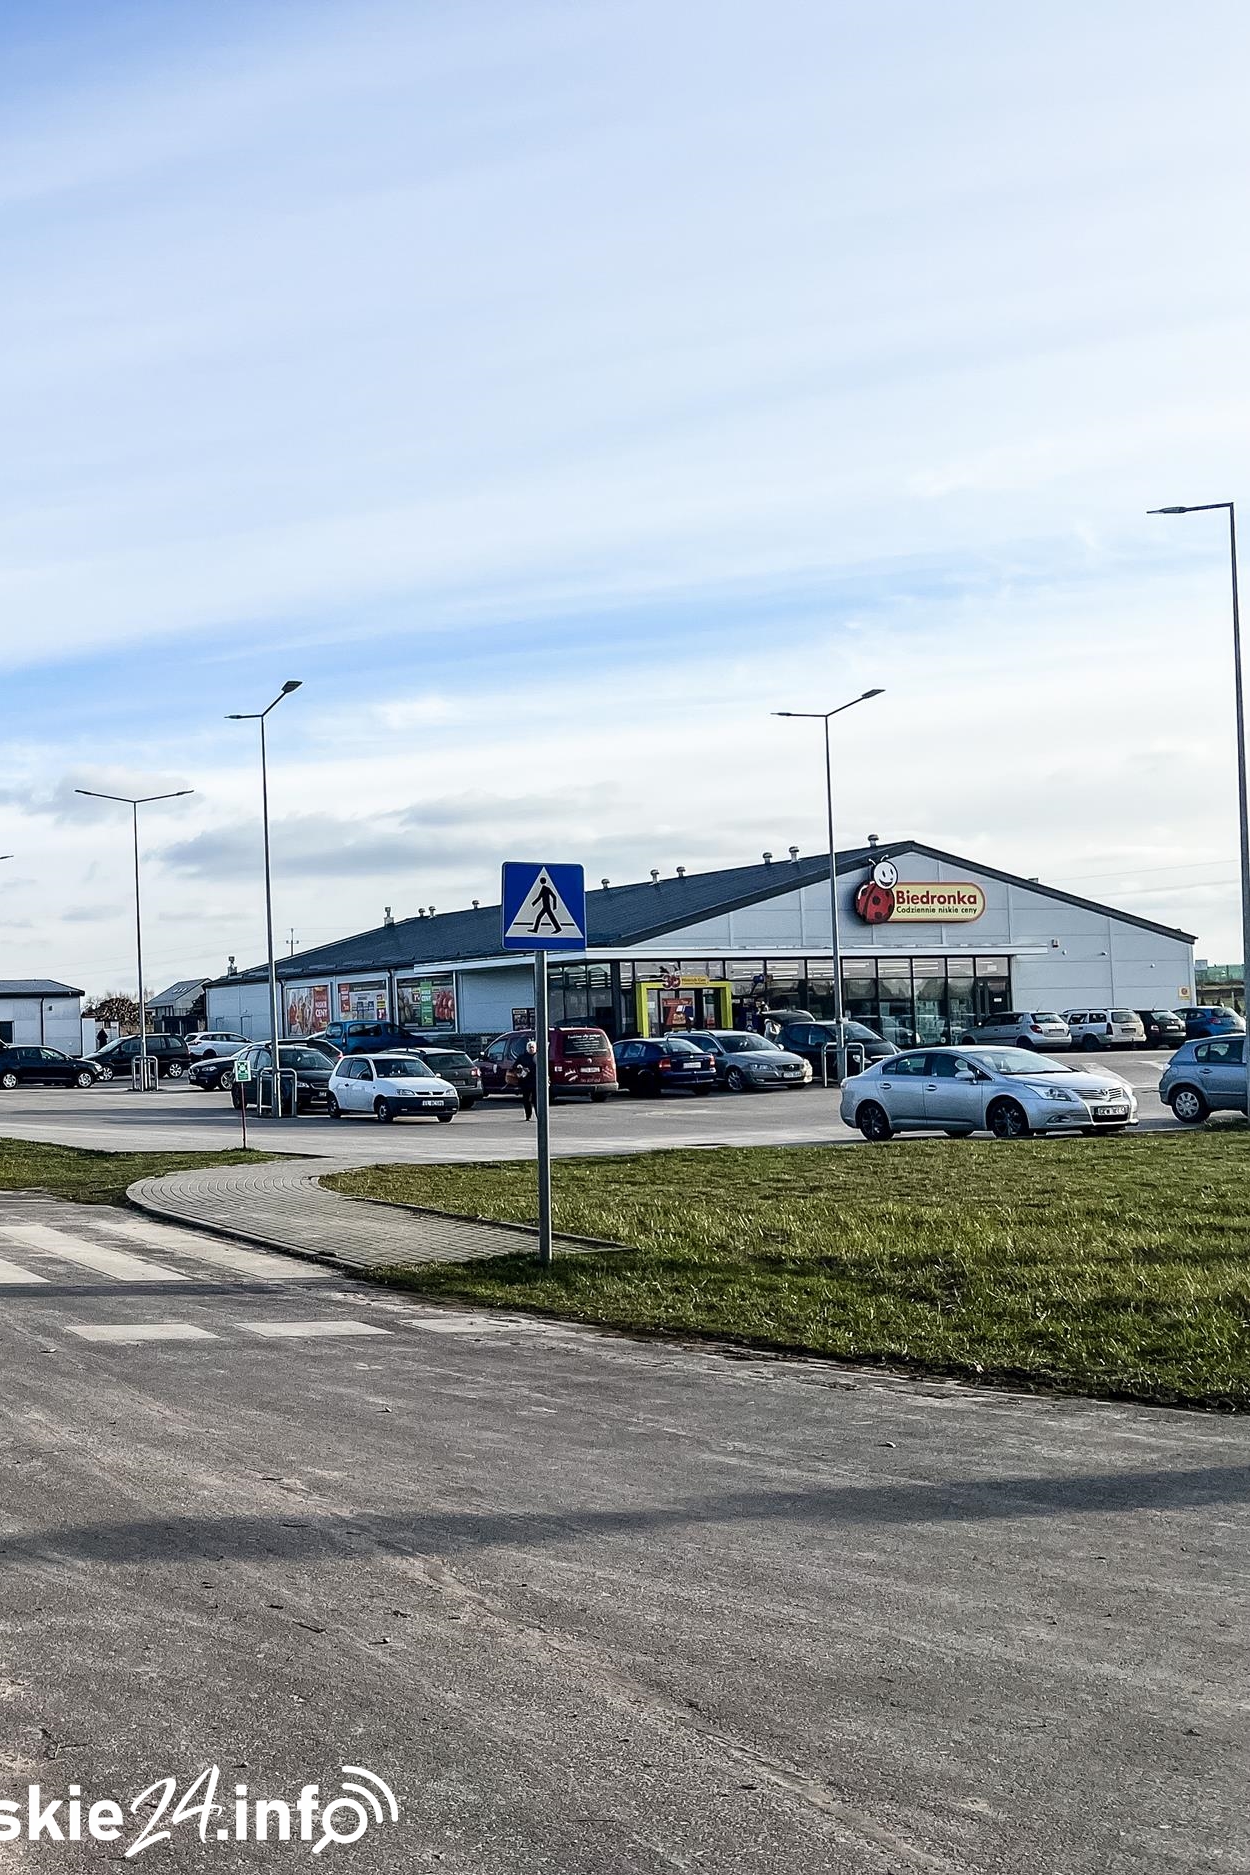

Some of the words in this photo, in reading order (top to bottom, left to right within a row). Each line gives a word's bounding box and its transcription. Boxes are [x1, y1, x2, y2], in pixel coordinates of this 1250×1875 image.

[896, 890, 977, 905] Biedronka
[896, 906, 936, 914] Codziennie
[938, 906, 959, 914] niskie
[961, 907, 978, 915] ceny
